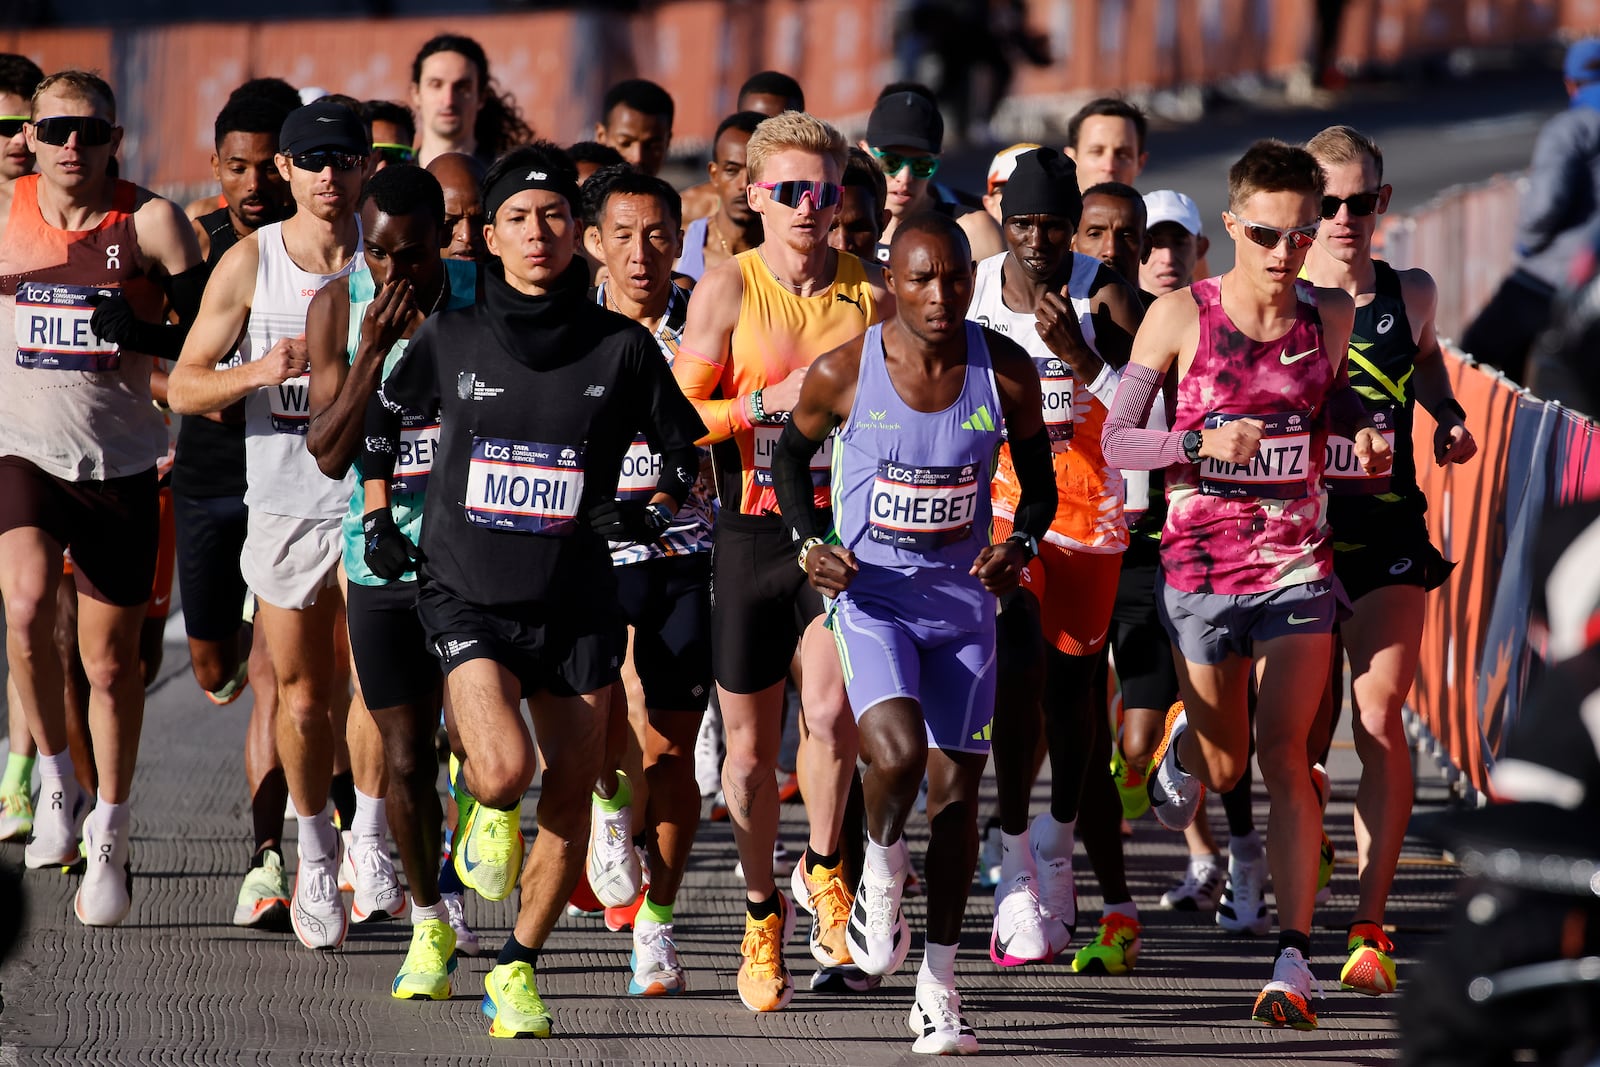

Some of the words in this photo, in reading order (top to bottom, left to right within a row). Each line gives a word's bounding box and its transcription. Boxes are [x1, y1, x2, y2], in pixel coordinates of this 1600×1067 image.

[27, 286, 51, 303] tcs
[52, 293, 87, 301] CONSULTANCY
[30, 315, 101, 347] RILE
[484, 441, 511, 460] tcs
[512, 450, 549, 459] CONSULTANCY
[512, 455, 536, 463] SERVICES
[557, 459, 577, 467] TATA
[887, 463, 912, 482] tcs
[958, 475, 974, 484] TATA
[484, 473, 568, 511] MORII
[874, 491, 977, 524] CHEBET
